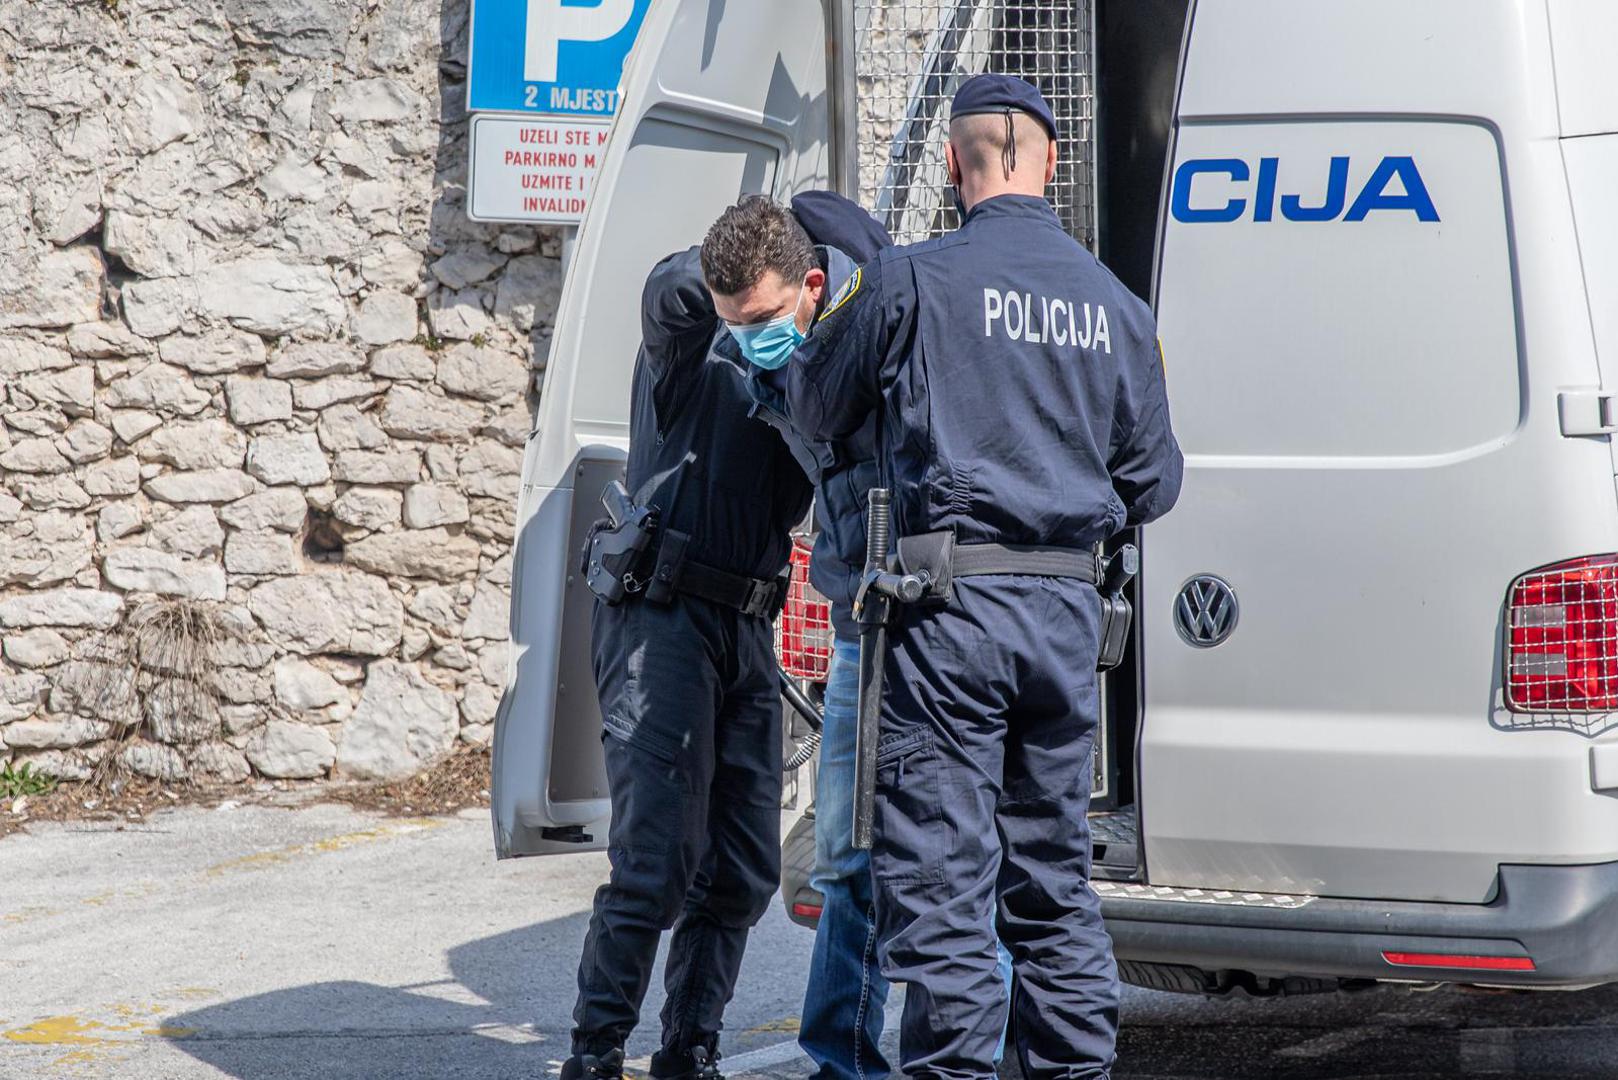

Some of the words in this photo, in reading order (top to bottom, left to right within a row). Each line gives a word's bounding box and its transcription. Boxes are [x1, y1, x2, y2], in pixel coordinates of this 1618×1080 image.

[523, 0, 635, 82] P
[524, 85, 538, 107] 2
[551, 88, 617, 112] MJEST
[505, 151, 577, 168] PARKIRNO
[520, 128, 558, 145] UZELI
[565, 131, 590, 146] STE
[522, 175, 573, 190] UZMITE
[579, 176, 584, 191] I
[1171, 156, 1441, 223] CIJA
[984, 288, 1111, 354] POLICIJA
[1178, 578, 1235, 643] VW
